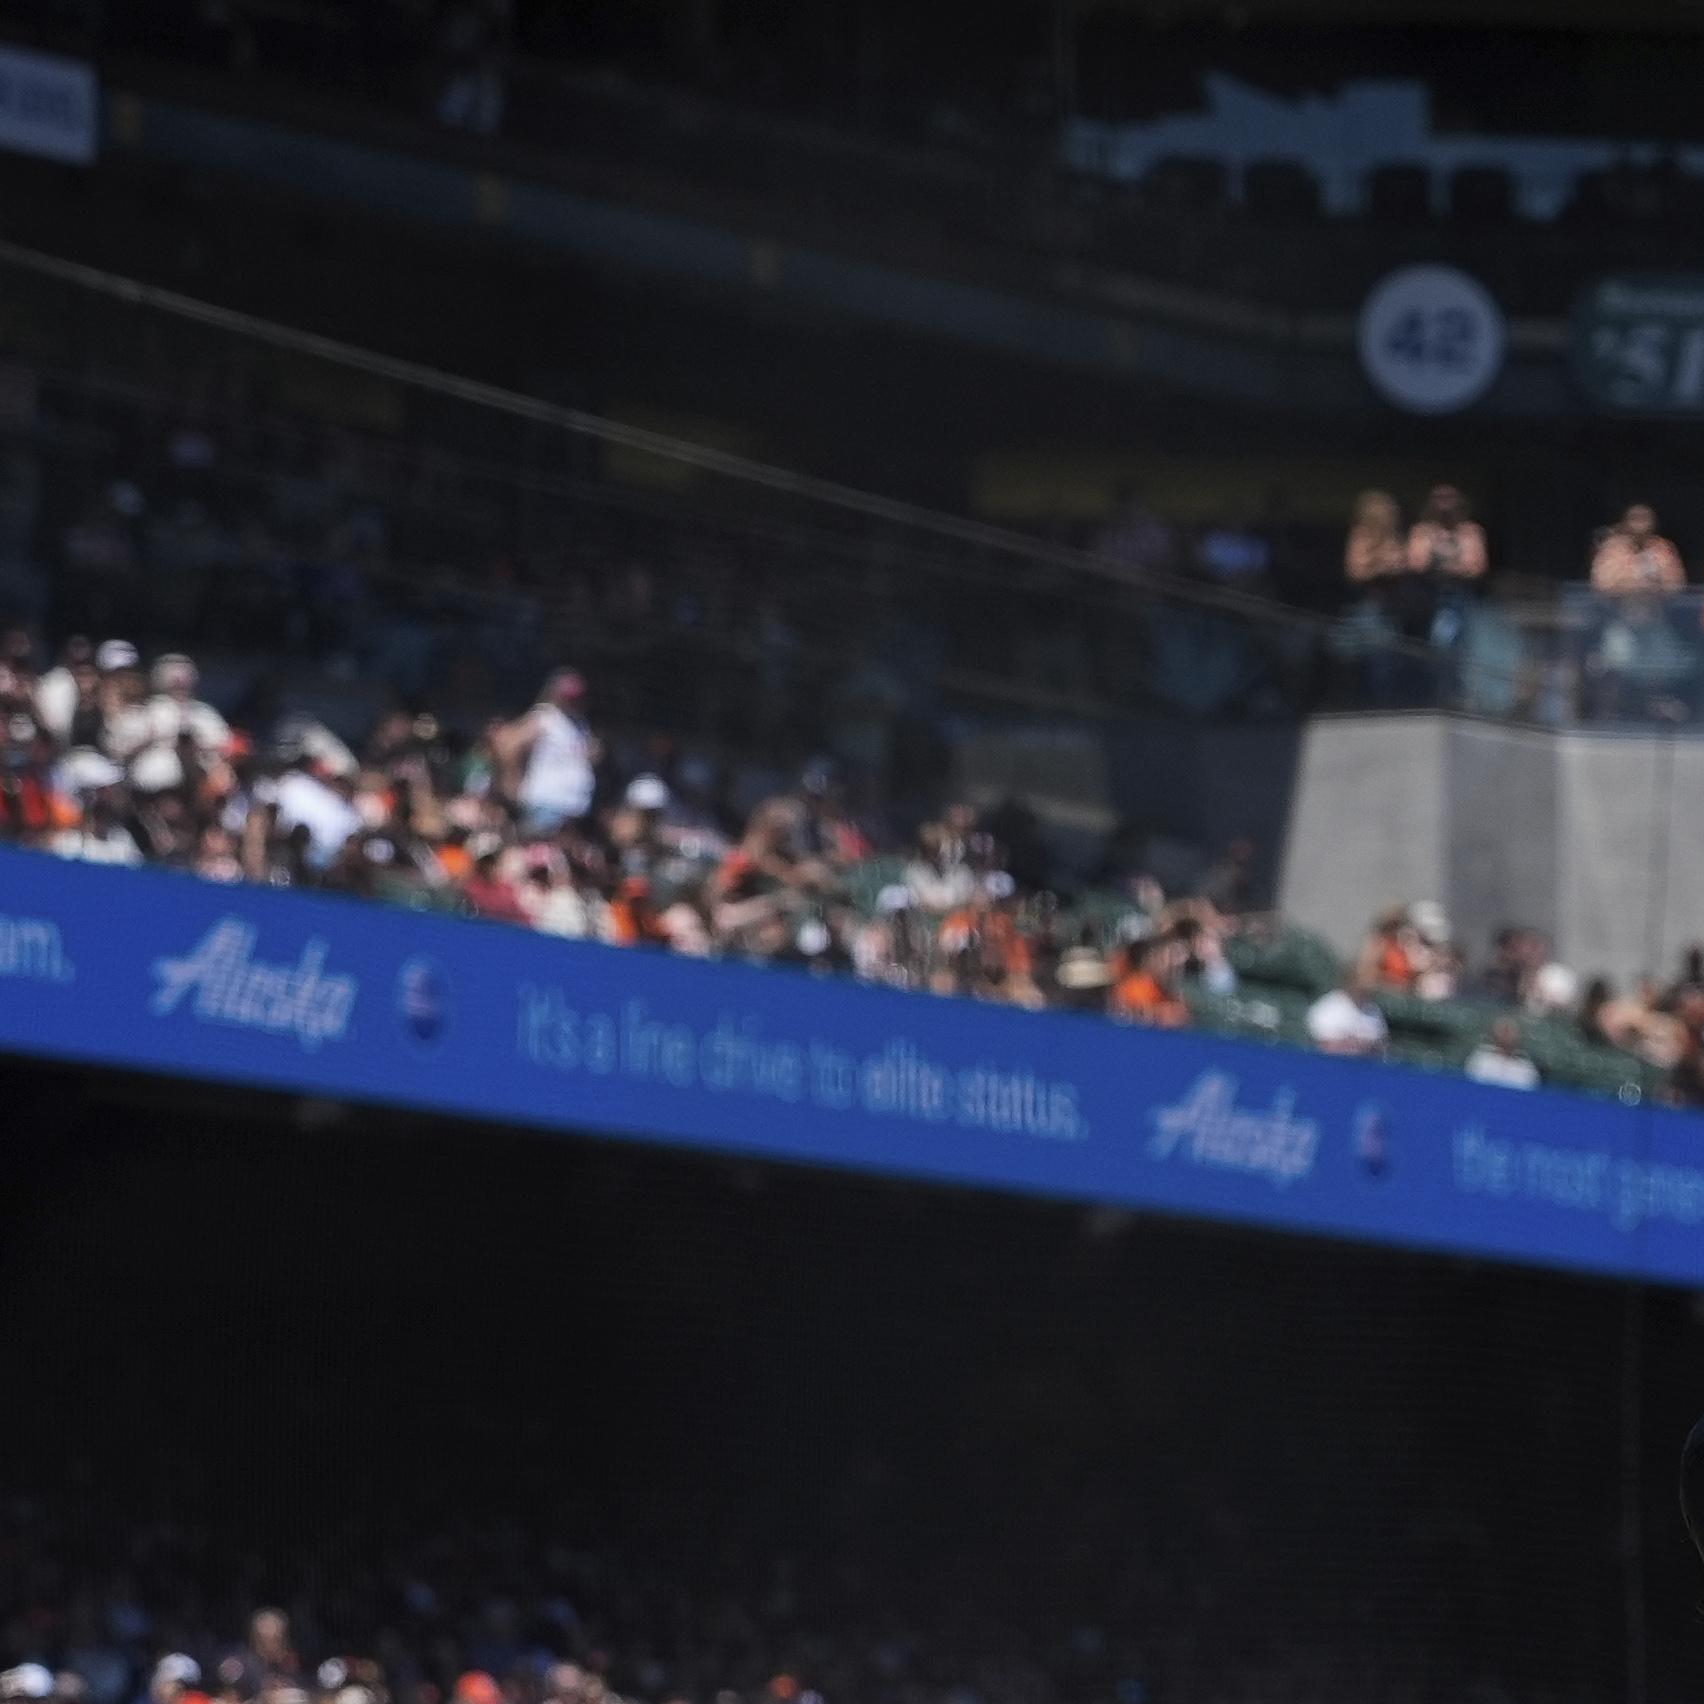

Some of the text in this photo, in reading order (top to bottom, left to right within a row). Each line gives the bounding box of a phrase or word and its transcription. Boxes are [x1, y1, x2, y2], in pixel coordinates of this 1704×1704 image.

[1387, 307, 1477, 372] 42
[150, 915, 357, 1052] Alaska
[1144, 1064, 1321, 1190] Alaska
